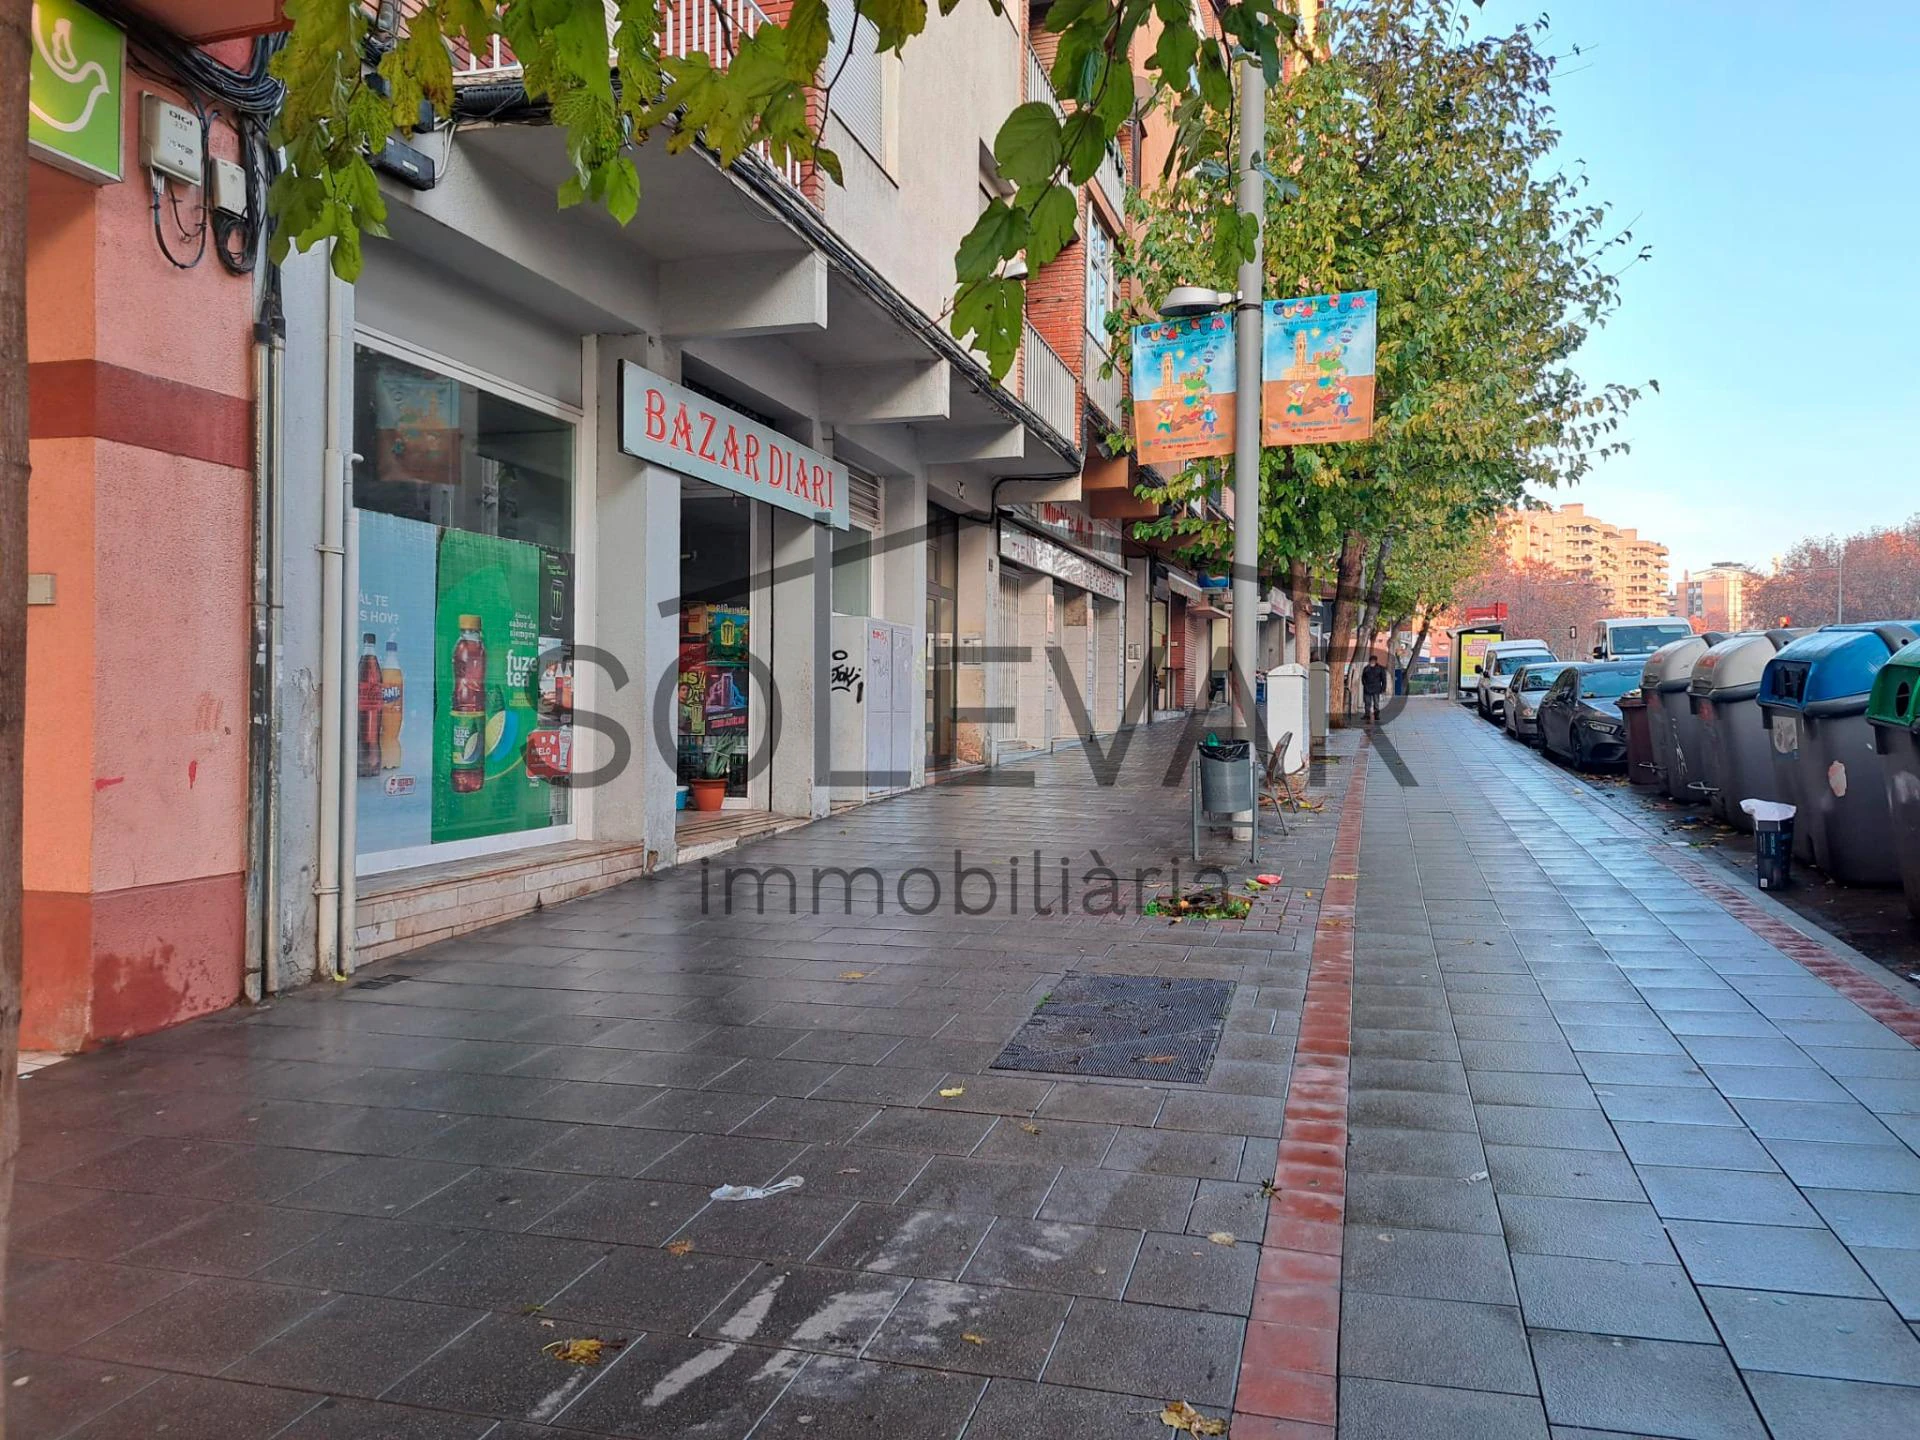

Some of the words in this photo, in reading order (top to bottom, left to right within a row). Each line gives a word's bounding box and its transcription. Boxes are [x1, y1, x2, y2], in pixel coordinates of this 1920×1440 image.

[169, 110, 193, 127] DIGI
[645, 388, 761, 485] BAZAR
[767, 443, 834, 510] DIARI
[374, 594, 389, 607] TE
[370, 611, 399, 624] HOY?
[506, 649, 538, 672] fuze
[506, 670, 530, 687] tea
